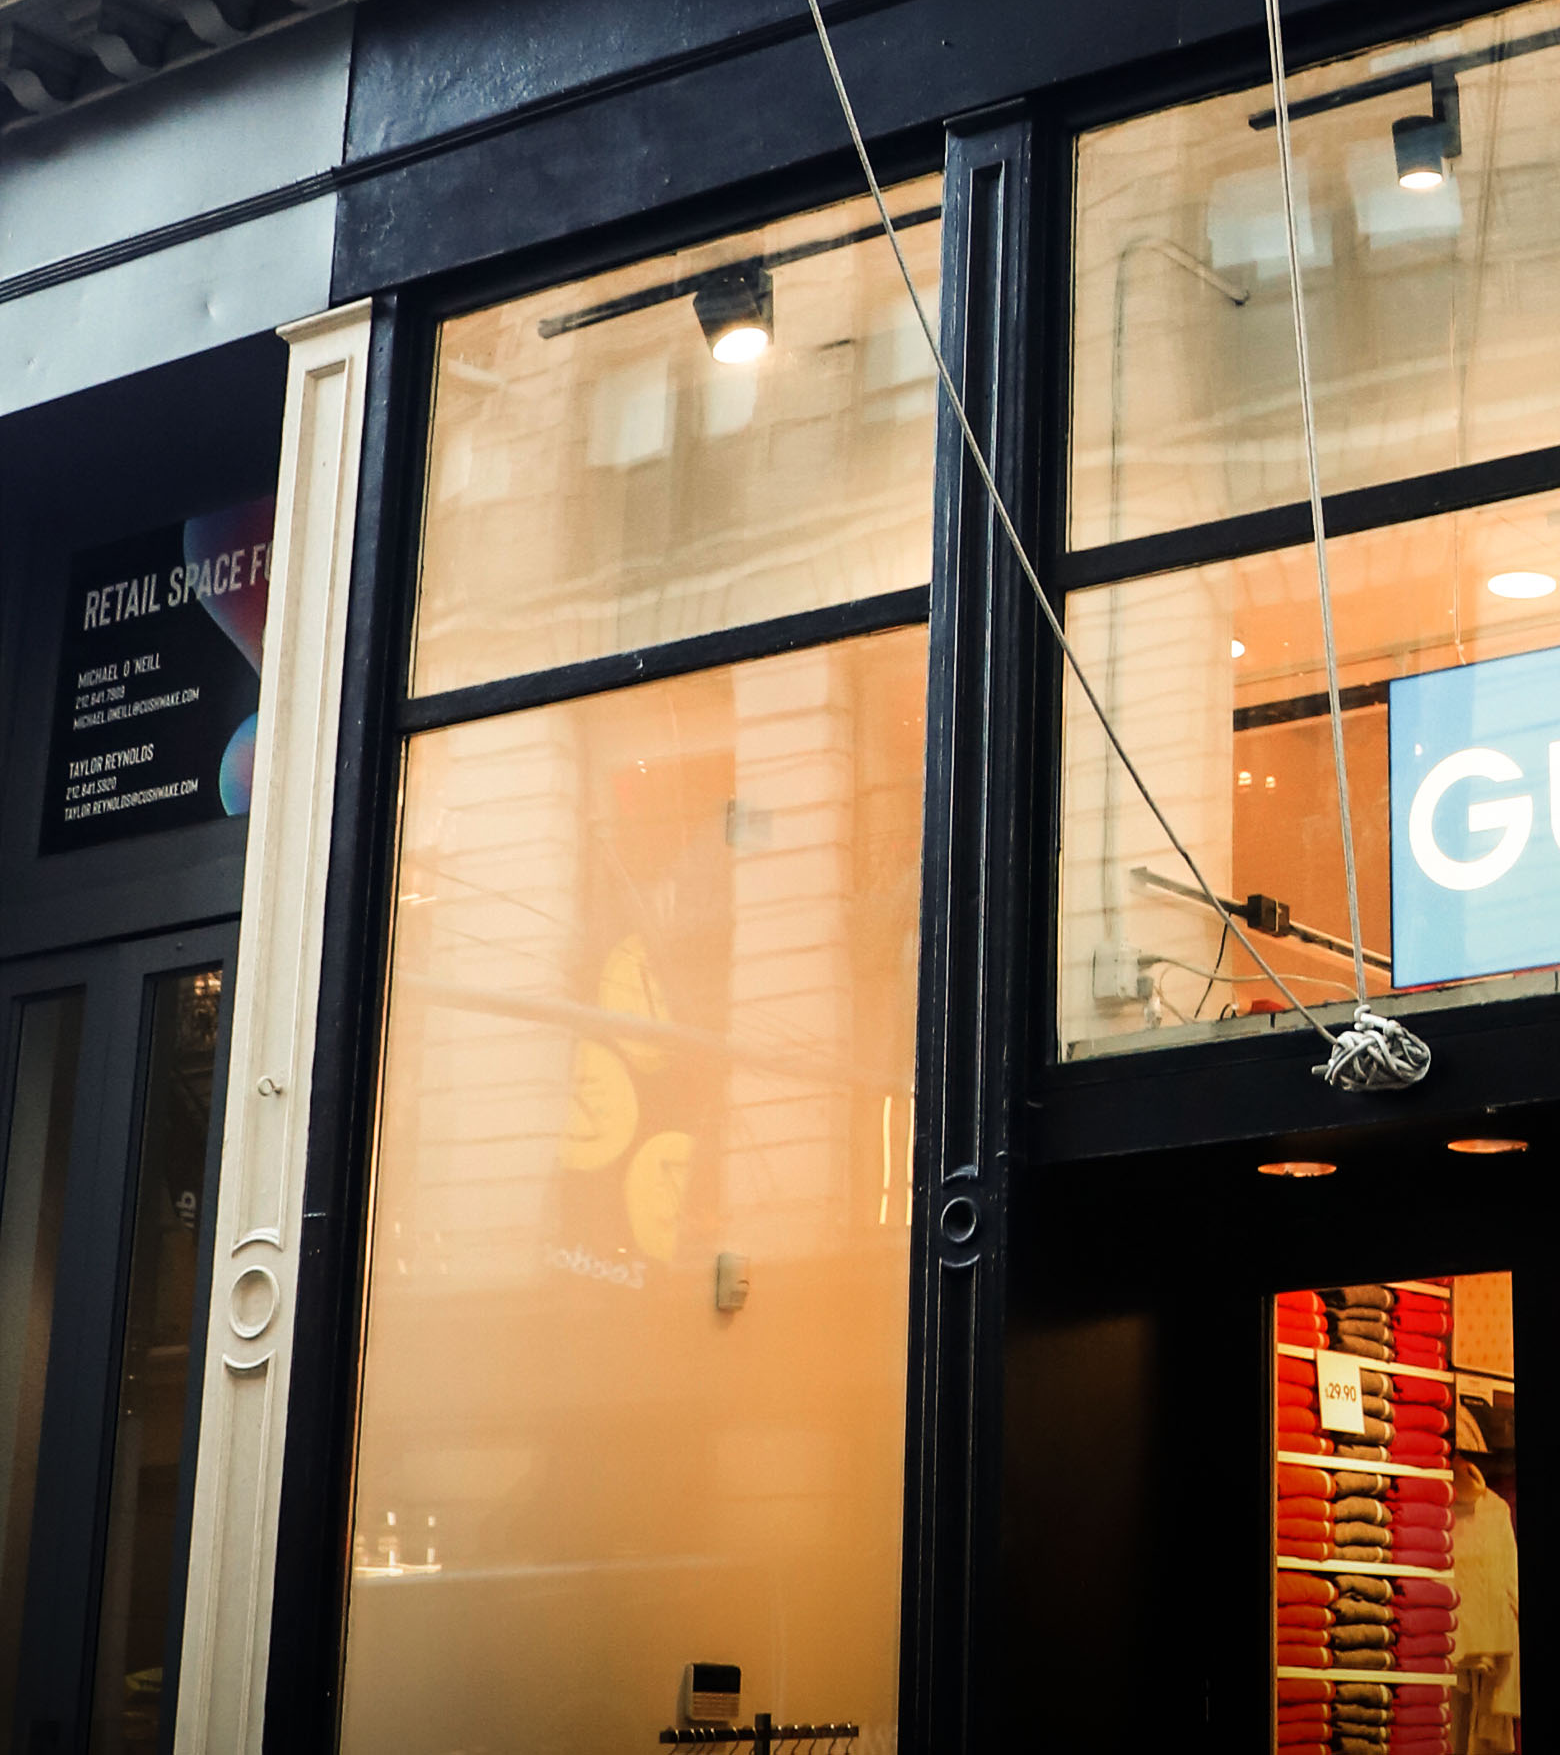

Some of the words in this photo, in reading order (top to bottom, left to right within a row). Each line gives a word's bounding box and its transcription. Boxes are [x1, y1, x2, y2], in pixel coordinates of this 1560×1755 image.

[83, 573, 161, 631] RETAIL
[167, 549, 246, 608] SPACE
[77, 664, 119, 690] MICHAEL
[69, 755, 104, 780] TAYLOR
[104, 743, 155, 772] REYNOLDS
